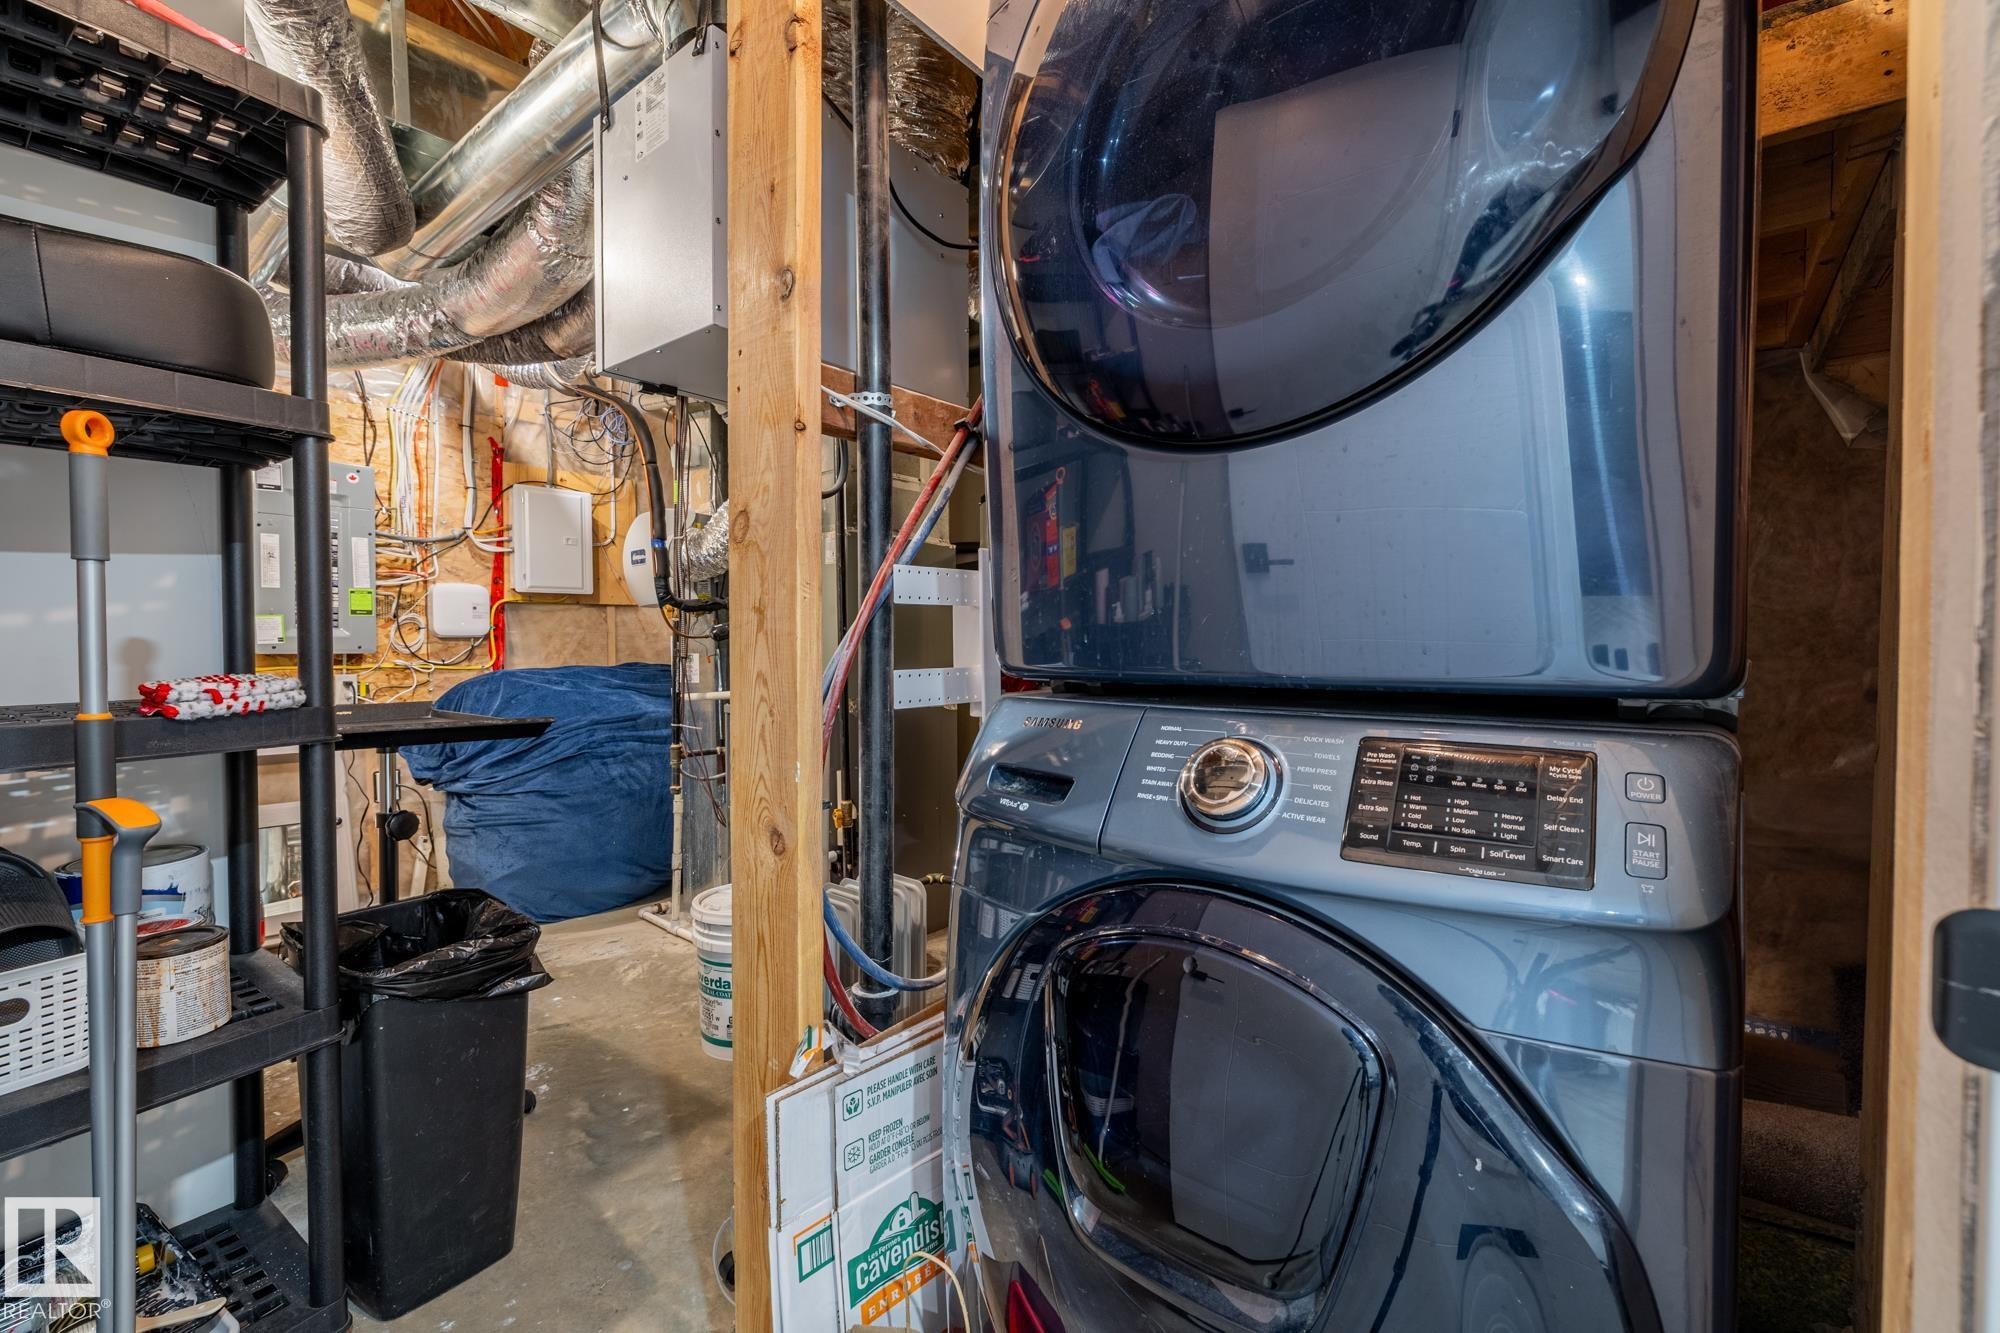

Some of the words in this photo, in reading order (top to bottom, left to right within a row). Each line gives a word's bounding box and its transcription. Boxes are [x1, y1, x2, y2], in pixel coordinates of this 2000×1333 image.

[1024, 717, 1083, 729] SAMSUNG
[1562, 767, 1582, 775] Cycle
[1547, 795, 1567, 803] Delay
[1569, 796, 1583, 804] End
[1631, 792, 1661, 800] POWER
[1294, 797, 1329, 807] DELICATES
[1282, 812, 1304, 820] ACTIVE
[1306, 815, 1326, 823] WEAR
[1501, 823, 1525, 831] Normal
[1402, 840, 1422, 848] Temp.
[1450, 846, 1466, 854] Spin
[1633, 850, 1659, 858] START
[1490, 850, 1503, 858] Soil
[1505, 852, 1525, 861] Level
[1542, 855, 1564, 863] Smart
[1566, 857, 1583, 865] Care
[1632, 859, 1660, 868] PAUSE
[867, 1079, 886, 1096] PLEASE
[888, 1069, 908, 1086] HANDLE
[909, 1063, 922, 1075] WITH
[923, 1056, 936, 1069] CARE
[867, 1093, 881, 1108] S.V.P.
[882, 1080, 912, 1101] MANIPULER
[913, 1073, 926, 1086] AVEC
[926, 1066, 937, 1080] SOIN
[868, 1129, 881, 1143] KEEP
[883, 1118, 903, 1135] FROZEN
[869, 1140, 880, 1152] HOLD
[869, 1146, 891, 1165] GARDER
[868, 1250, 878, 1261] Les
[879, 1236, 900, 1254] Fermes
